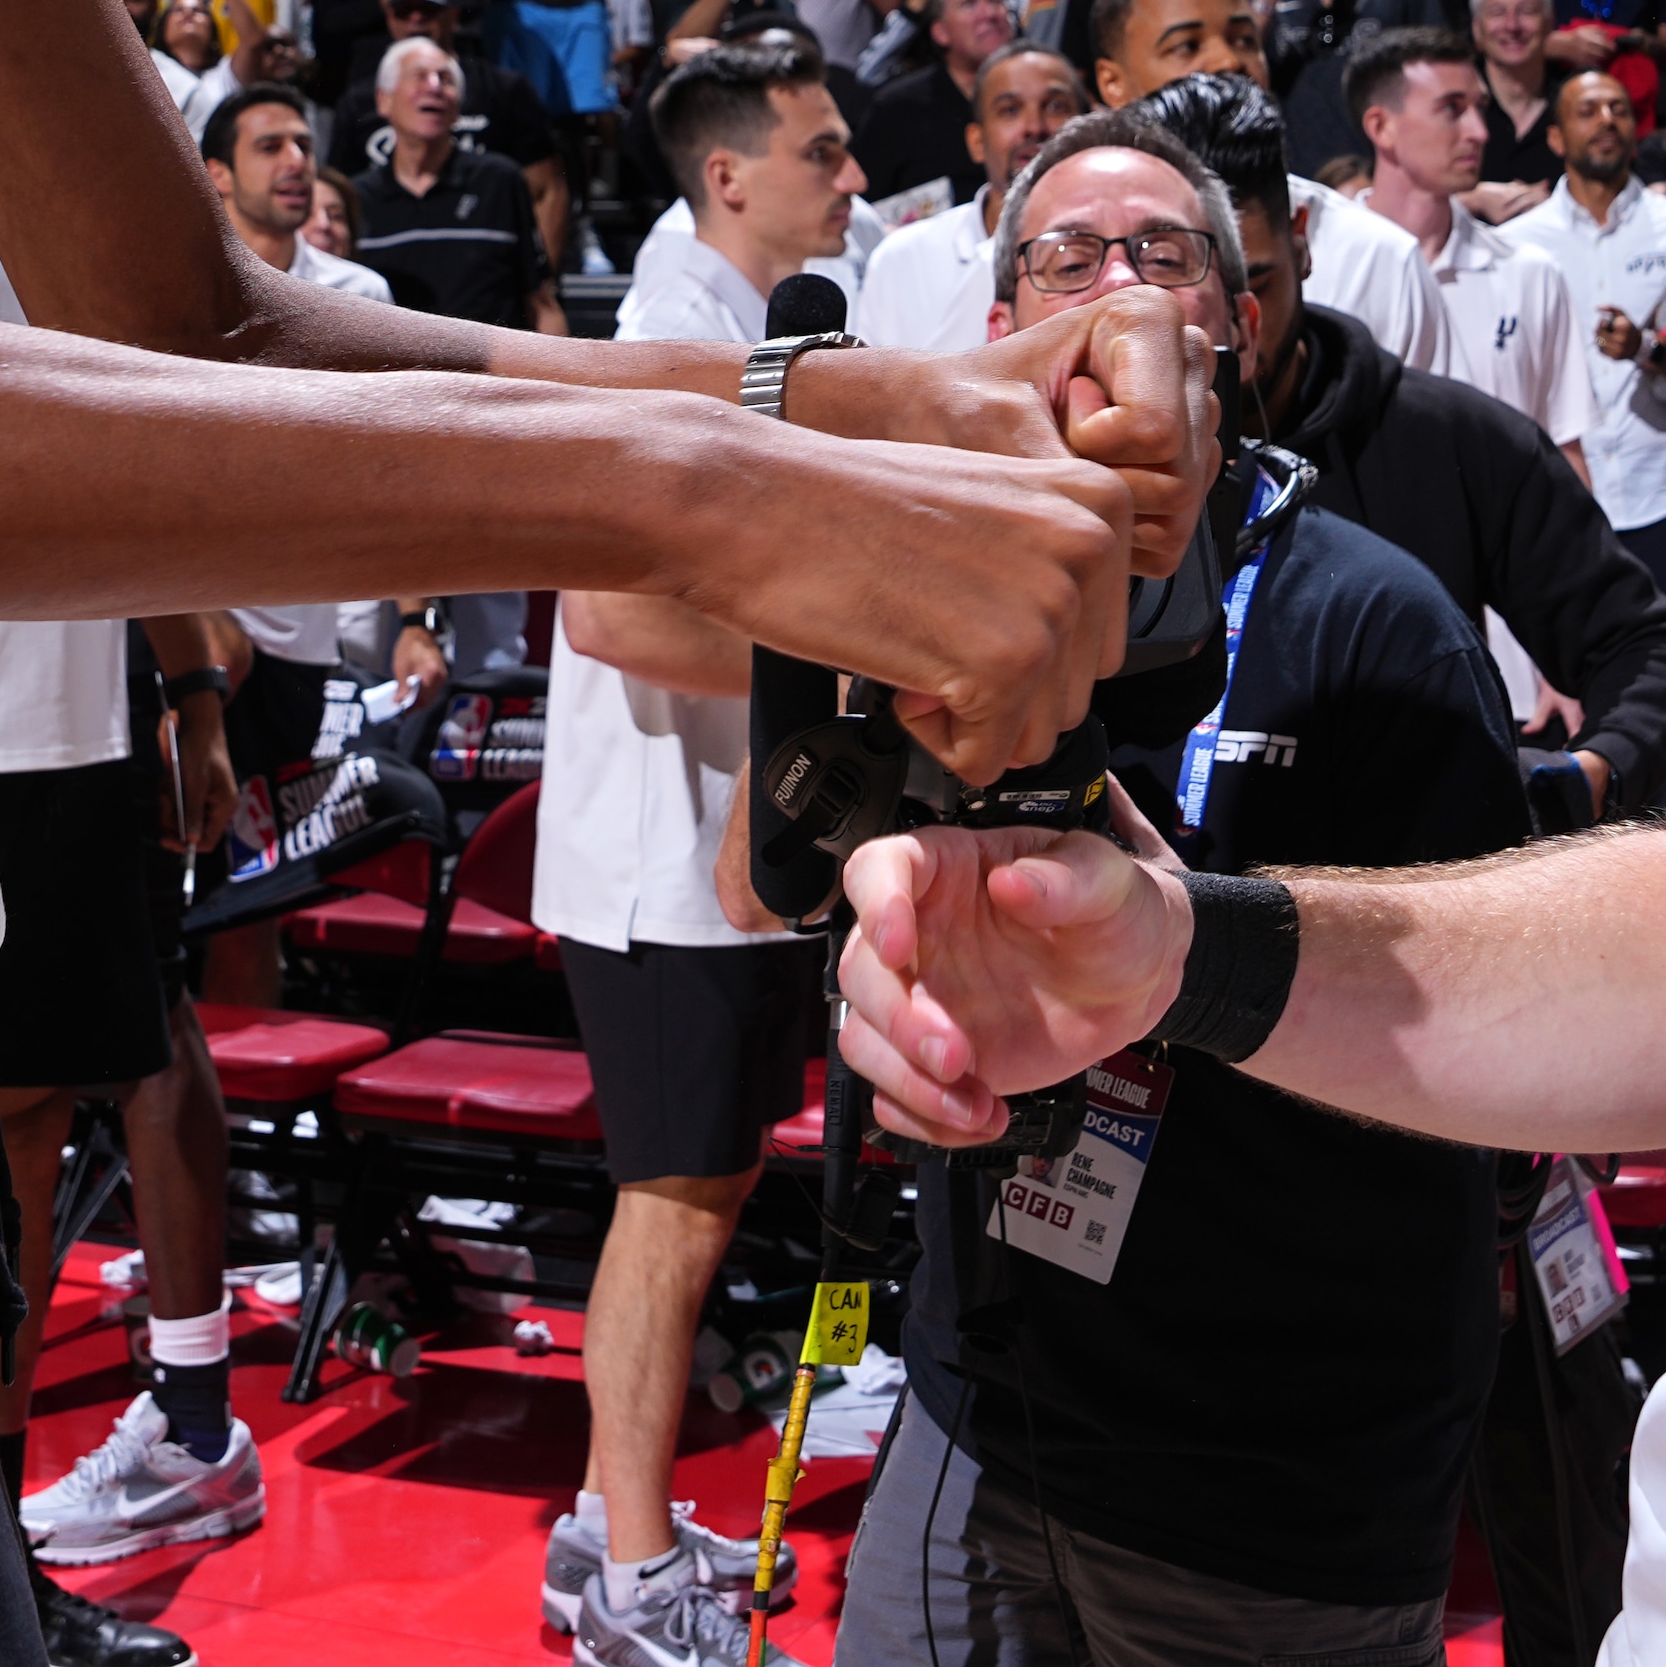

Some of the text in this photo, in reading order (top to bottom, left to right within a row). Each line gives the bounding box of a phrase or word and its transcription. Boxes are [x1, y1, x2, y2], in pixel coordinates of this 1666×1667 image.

[1226, 563, 1260, 629] SUMMER LEAGUE
[774, 752, 813, 806] FUJINON
[1182, 746, 1213, 827] SUMMER LEAGUE
[284, 793, 374, 862] LEAGUE
[828, 1079, 842, 1122] NEMAL
[1112, 1076, 1152, 1110] LEAGUE
[1083, 1110, 1145, 1146] DCAST
[1070, 1152, 1096, 1173] RENE
[1066, 1167, 1118, 1200] CHAMPAGNE
[1006, 1187, 1069, 1225] C F B
[831, 1319, 859, 1354] #3
